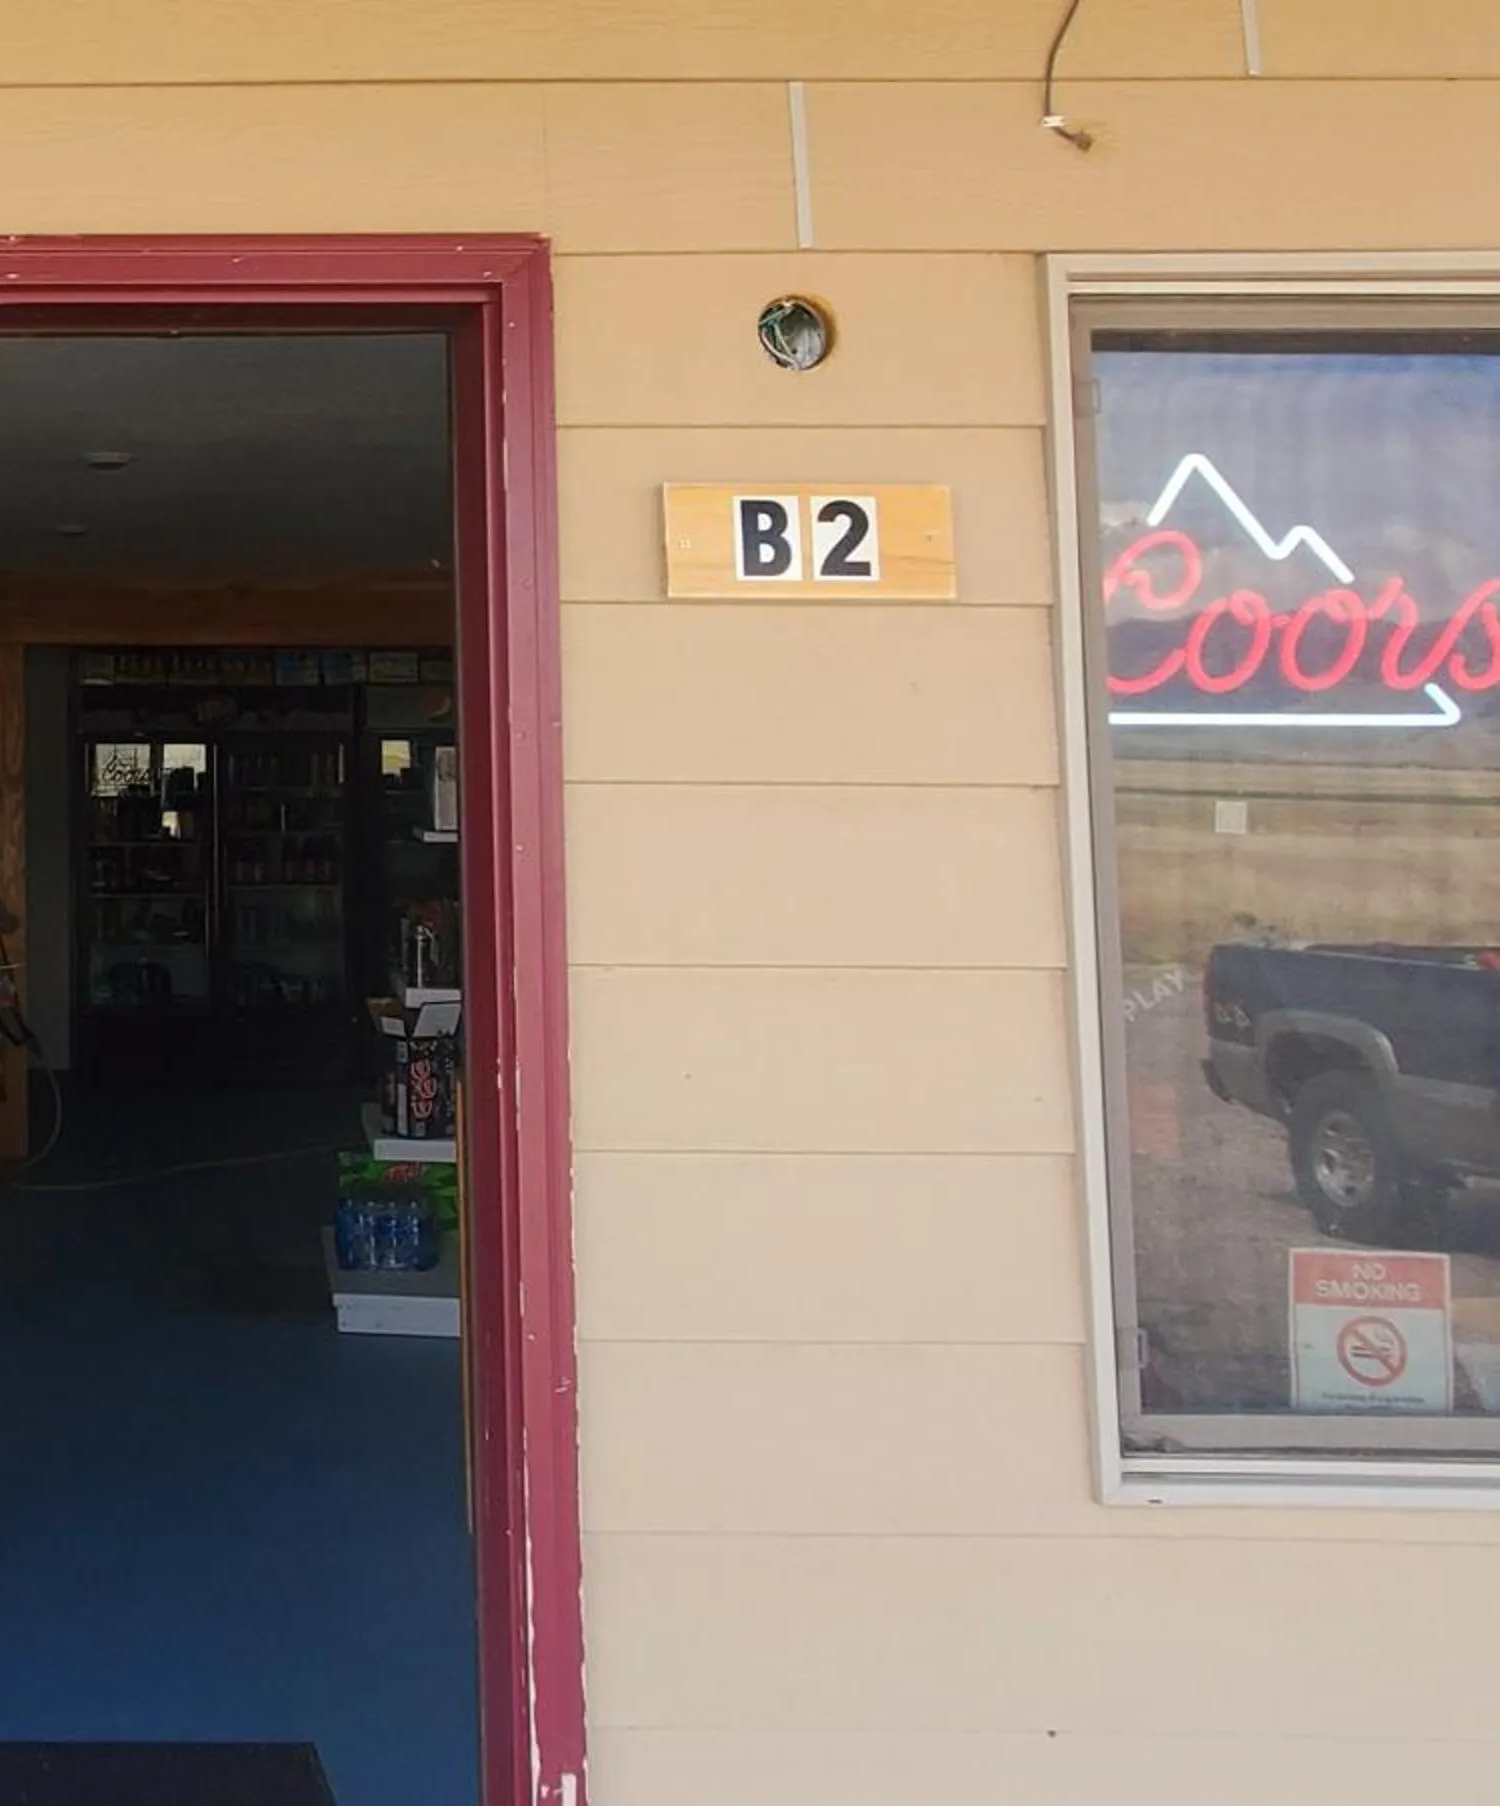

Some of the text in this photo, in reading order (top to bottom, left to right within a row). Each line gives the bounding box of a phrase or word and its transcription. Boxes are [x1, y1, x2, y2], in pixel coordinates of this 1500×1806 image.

[1103, 529, 1500, 695] Coors
[1351, 1262, 1387, 1281] NO
[1314, 1279, 1421, 1301] SMOKING
